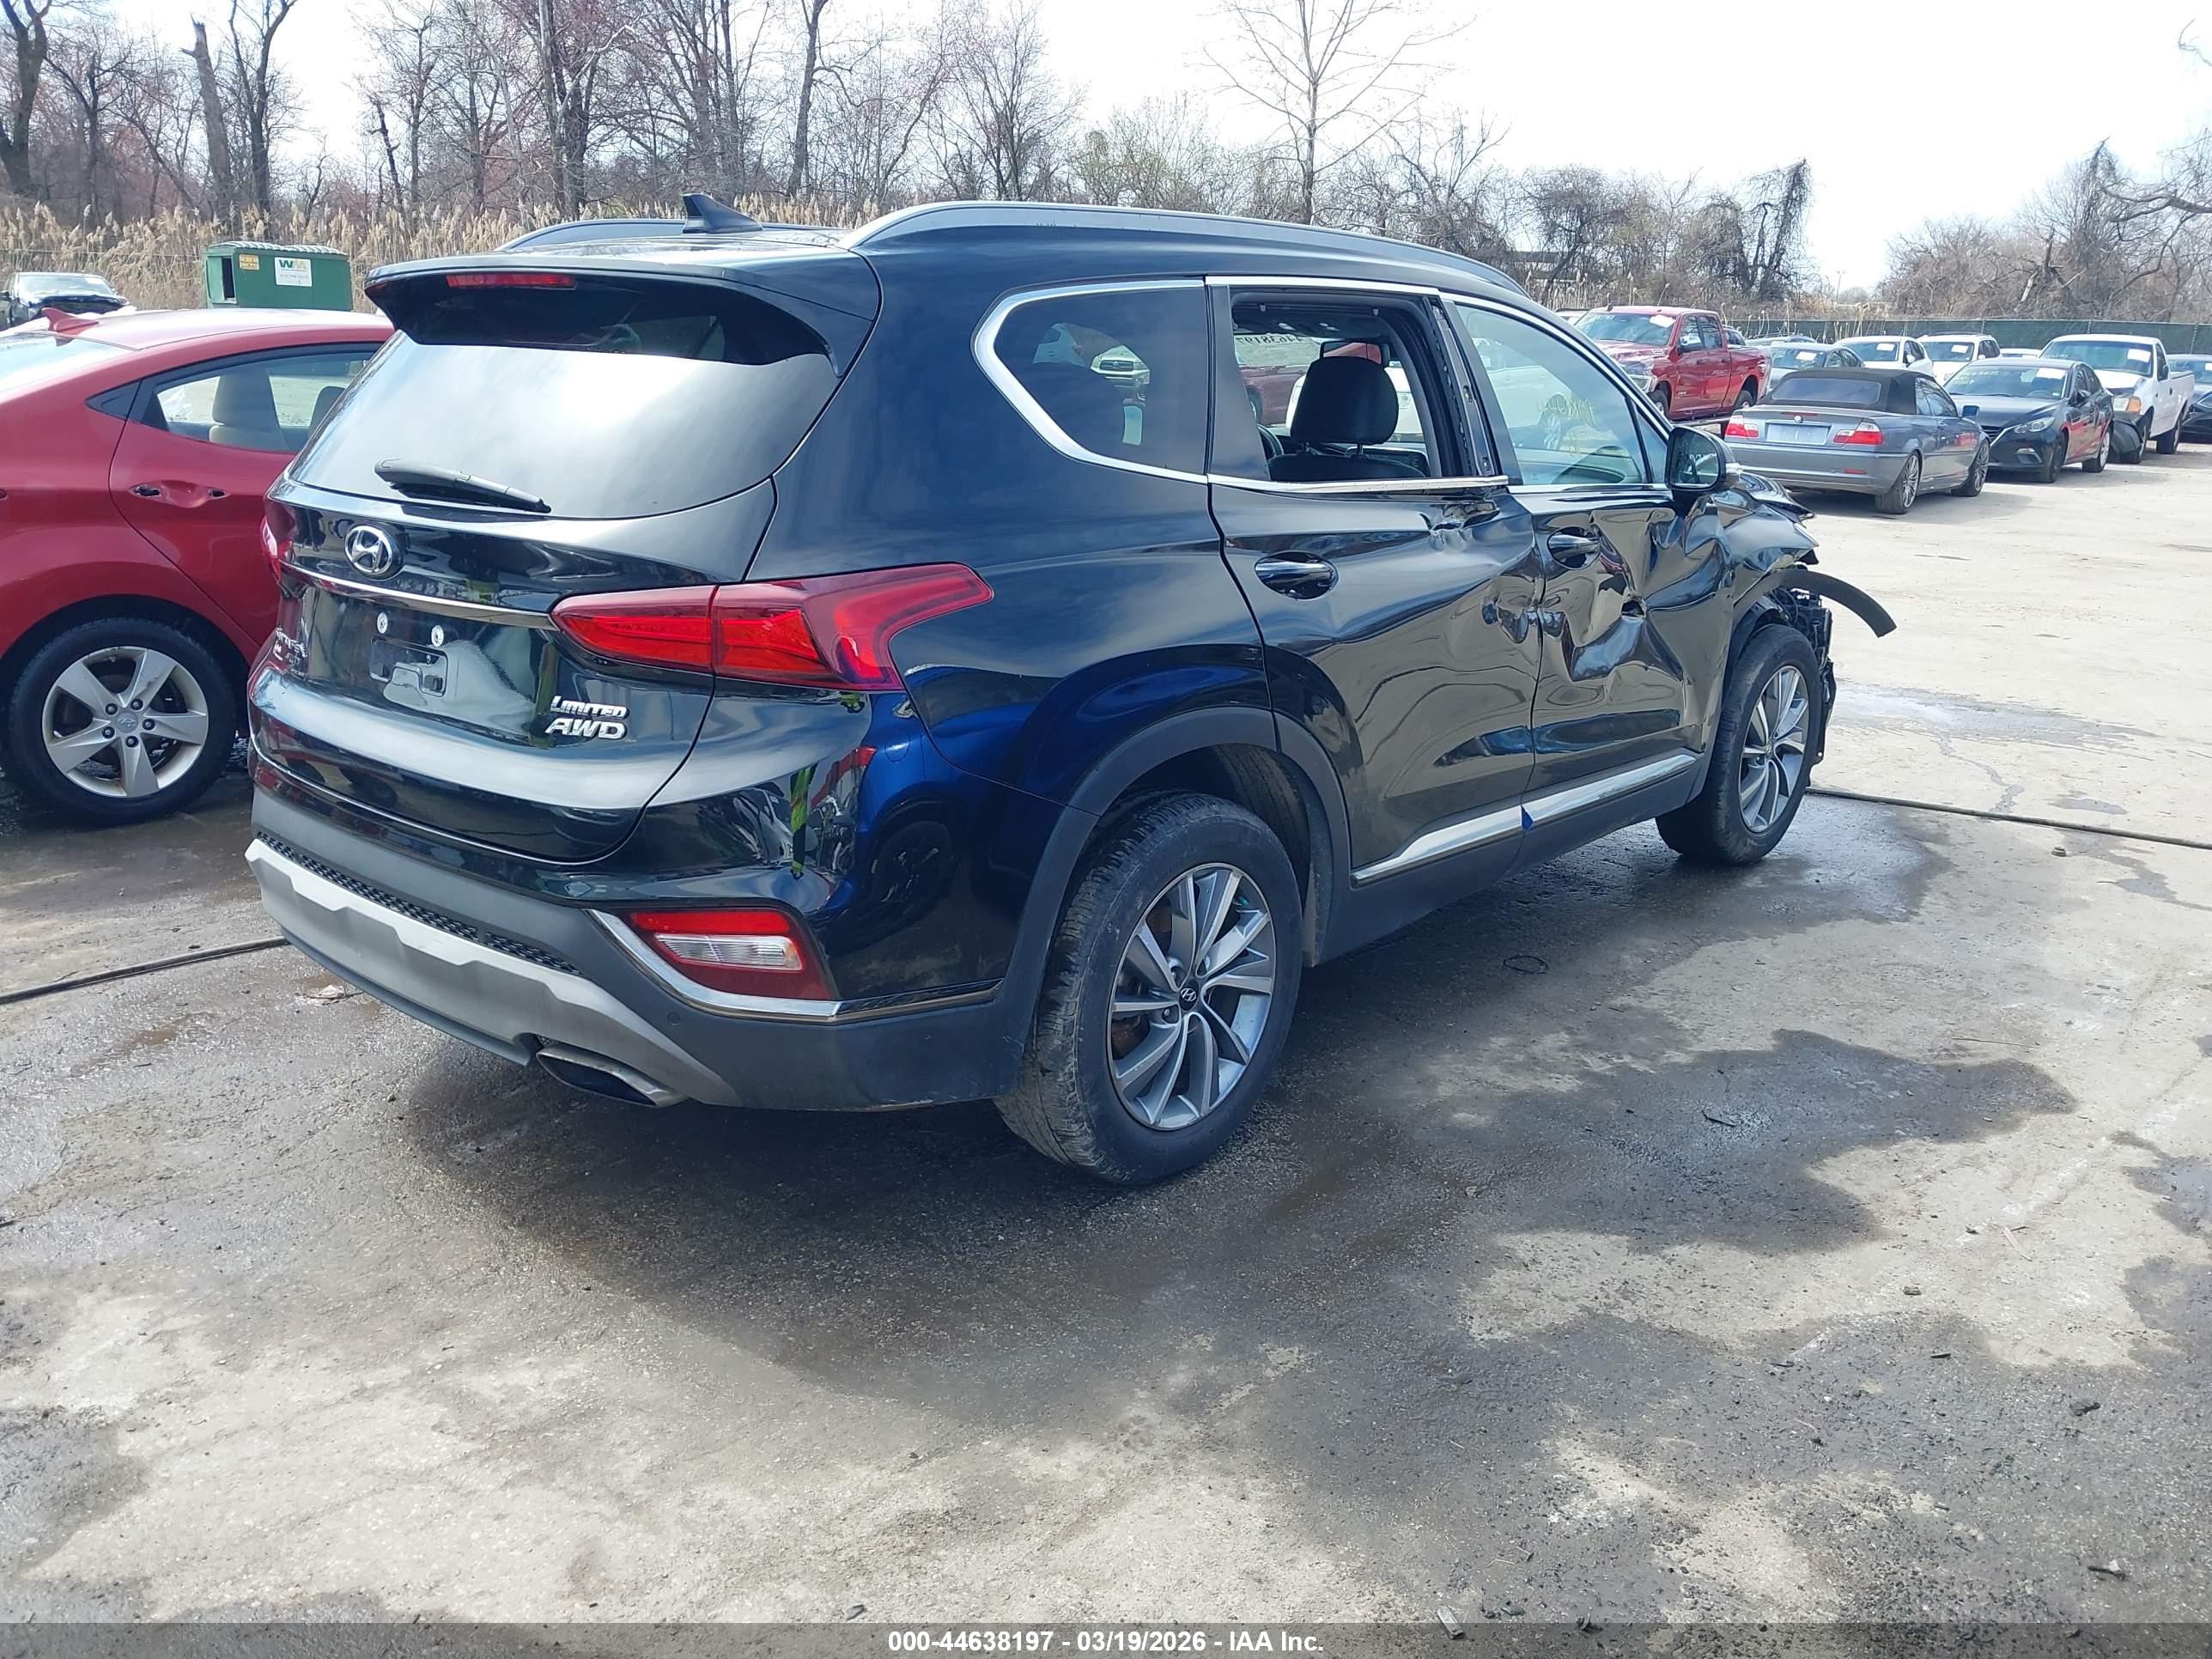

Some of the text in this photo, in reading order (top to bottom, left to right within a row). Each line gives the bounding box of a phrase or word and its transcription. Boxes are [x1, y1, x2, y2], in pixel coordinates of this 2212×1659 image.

[278, 259, 307, 269] WM
[550, 696, 628, 717] LIMITED
[544, 718, 627, 739] AWD
